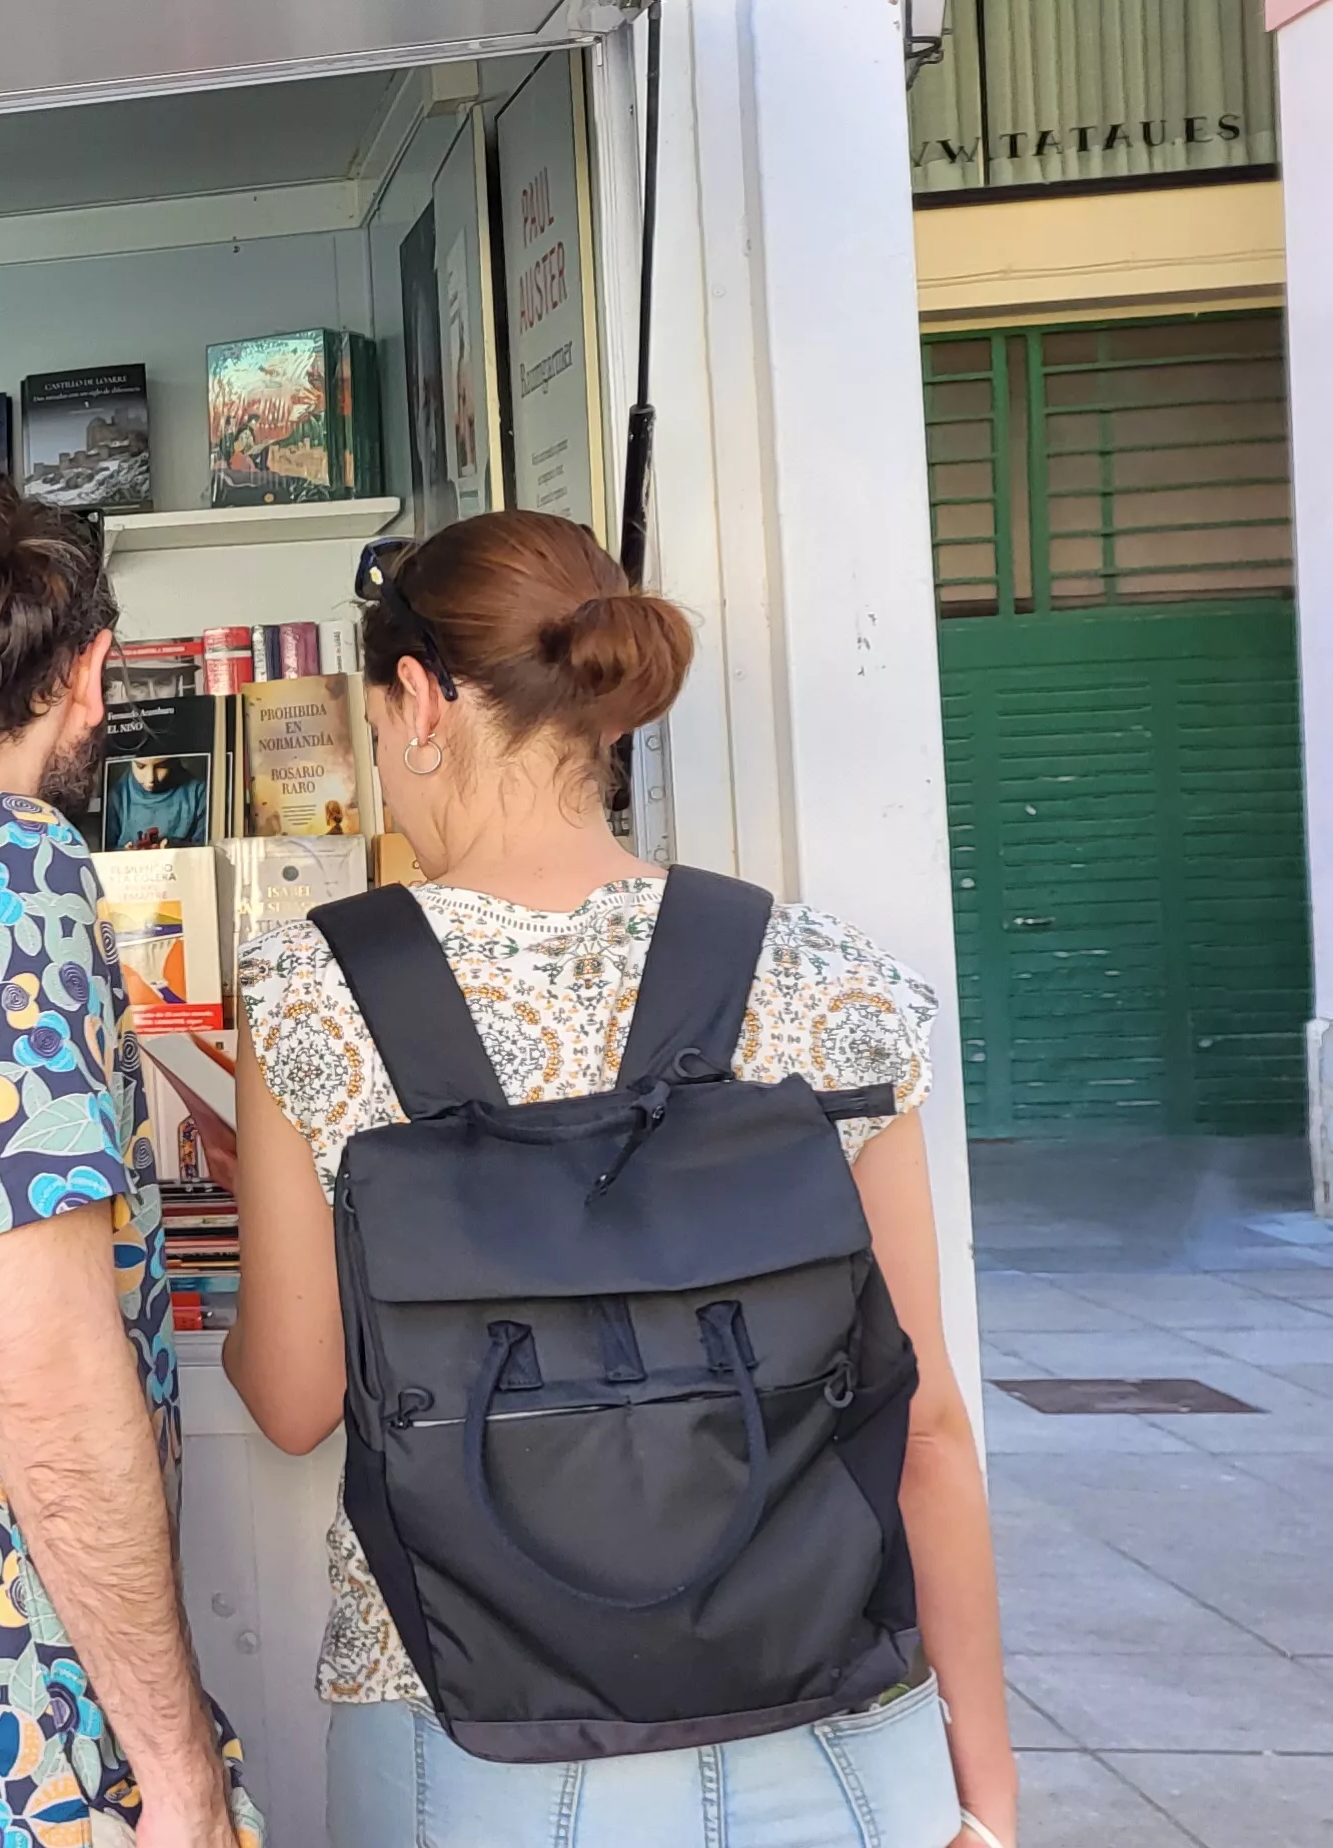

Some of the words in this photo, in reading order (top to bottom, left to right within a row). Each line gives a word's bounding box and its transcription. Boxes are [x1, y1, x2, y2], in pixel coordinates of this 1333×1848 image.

[522, 167, 555, 249] PAUL
[520, 242, 569, 335] AUSTER
[259, 703, 328, 722] PROHIBIDA
[107, 723, 119, 734] EL
[285, 720, 303, 735] EN
[258, 731, 334, 752] NORMANDÍA
[270, 764, 325, 781] ROSARIO
[281, 780, 316, 796] RARO
